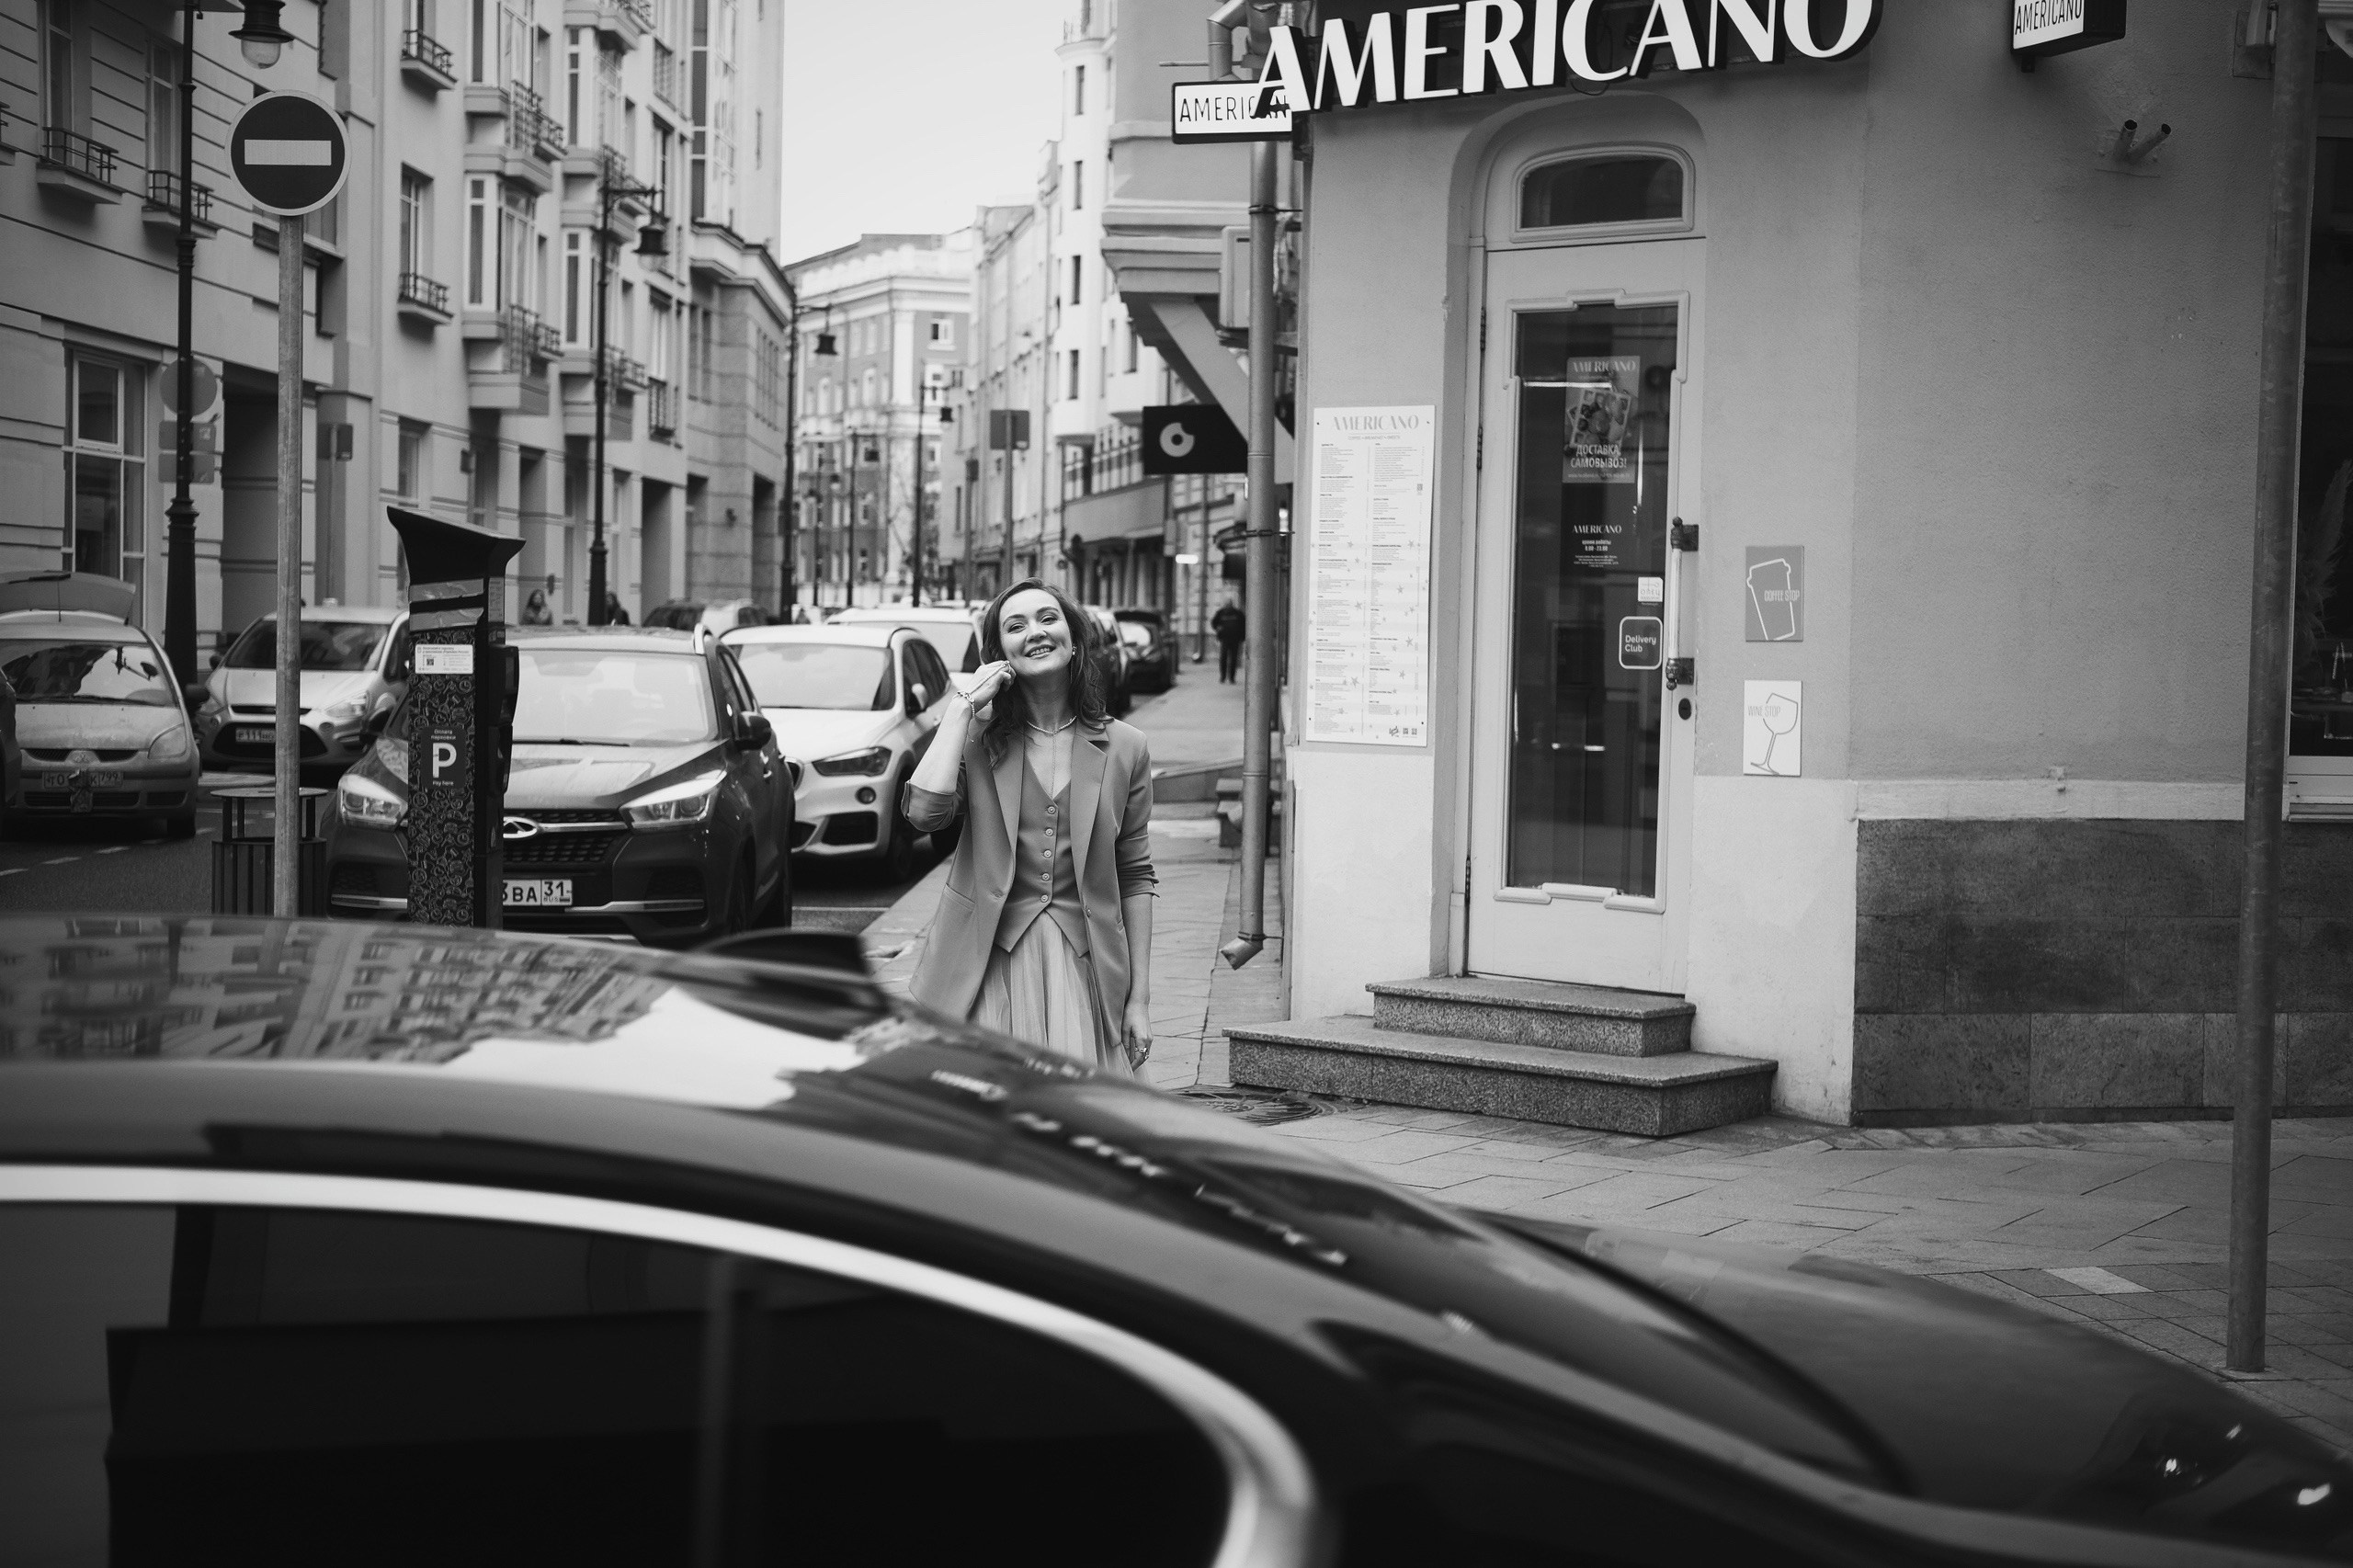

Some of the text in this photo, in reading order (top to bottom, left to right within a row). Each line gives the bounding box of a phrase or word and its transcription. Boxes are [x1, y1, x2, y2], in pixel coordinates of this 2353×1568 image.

[2015, 0, 2083, 35] AMERICANO
[1249, 0, 1873, 117] AMERICANO
[1333, 415, 1419, 431] AMERICANO
[1570, 458, 1627, 468] САМОВЫВОЗ!
[1572, 525, 1622, 534] AMERICANO
[1784, 589, 1801, 602] STOP
[1625, 634, 1656, 645] Delivery
[1624, 644, 1643, 653] Club
[1765, 705, 1781, 717] STOP
[433, 743, 457, 778] P
[544, 881, 564, 897] 31
